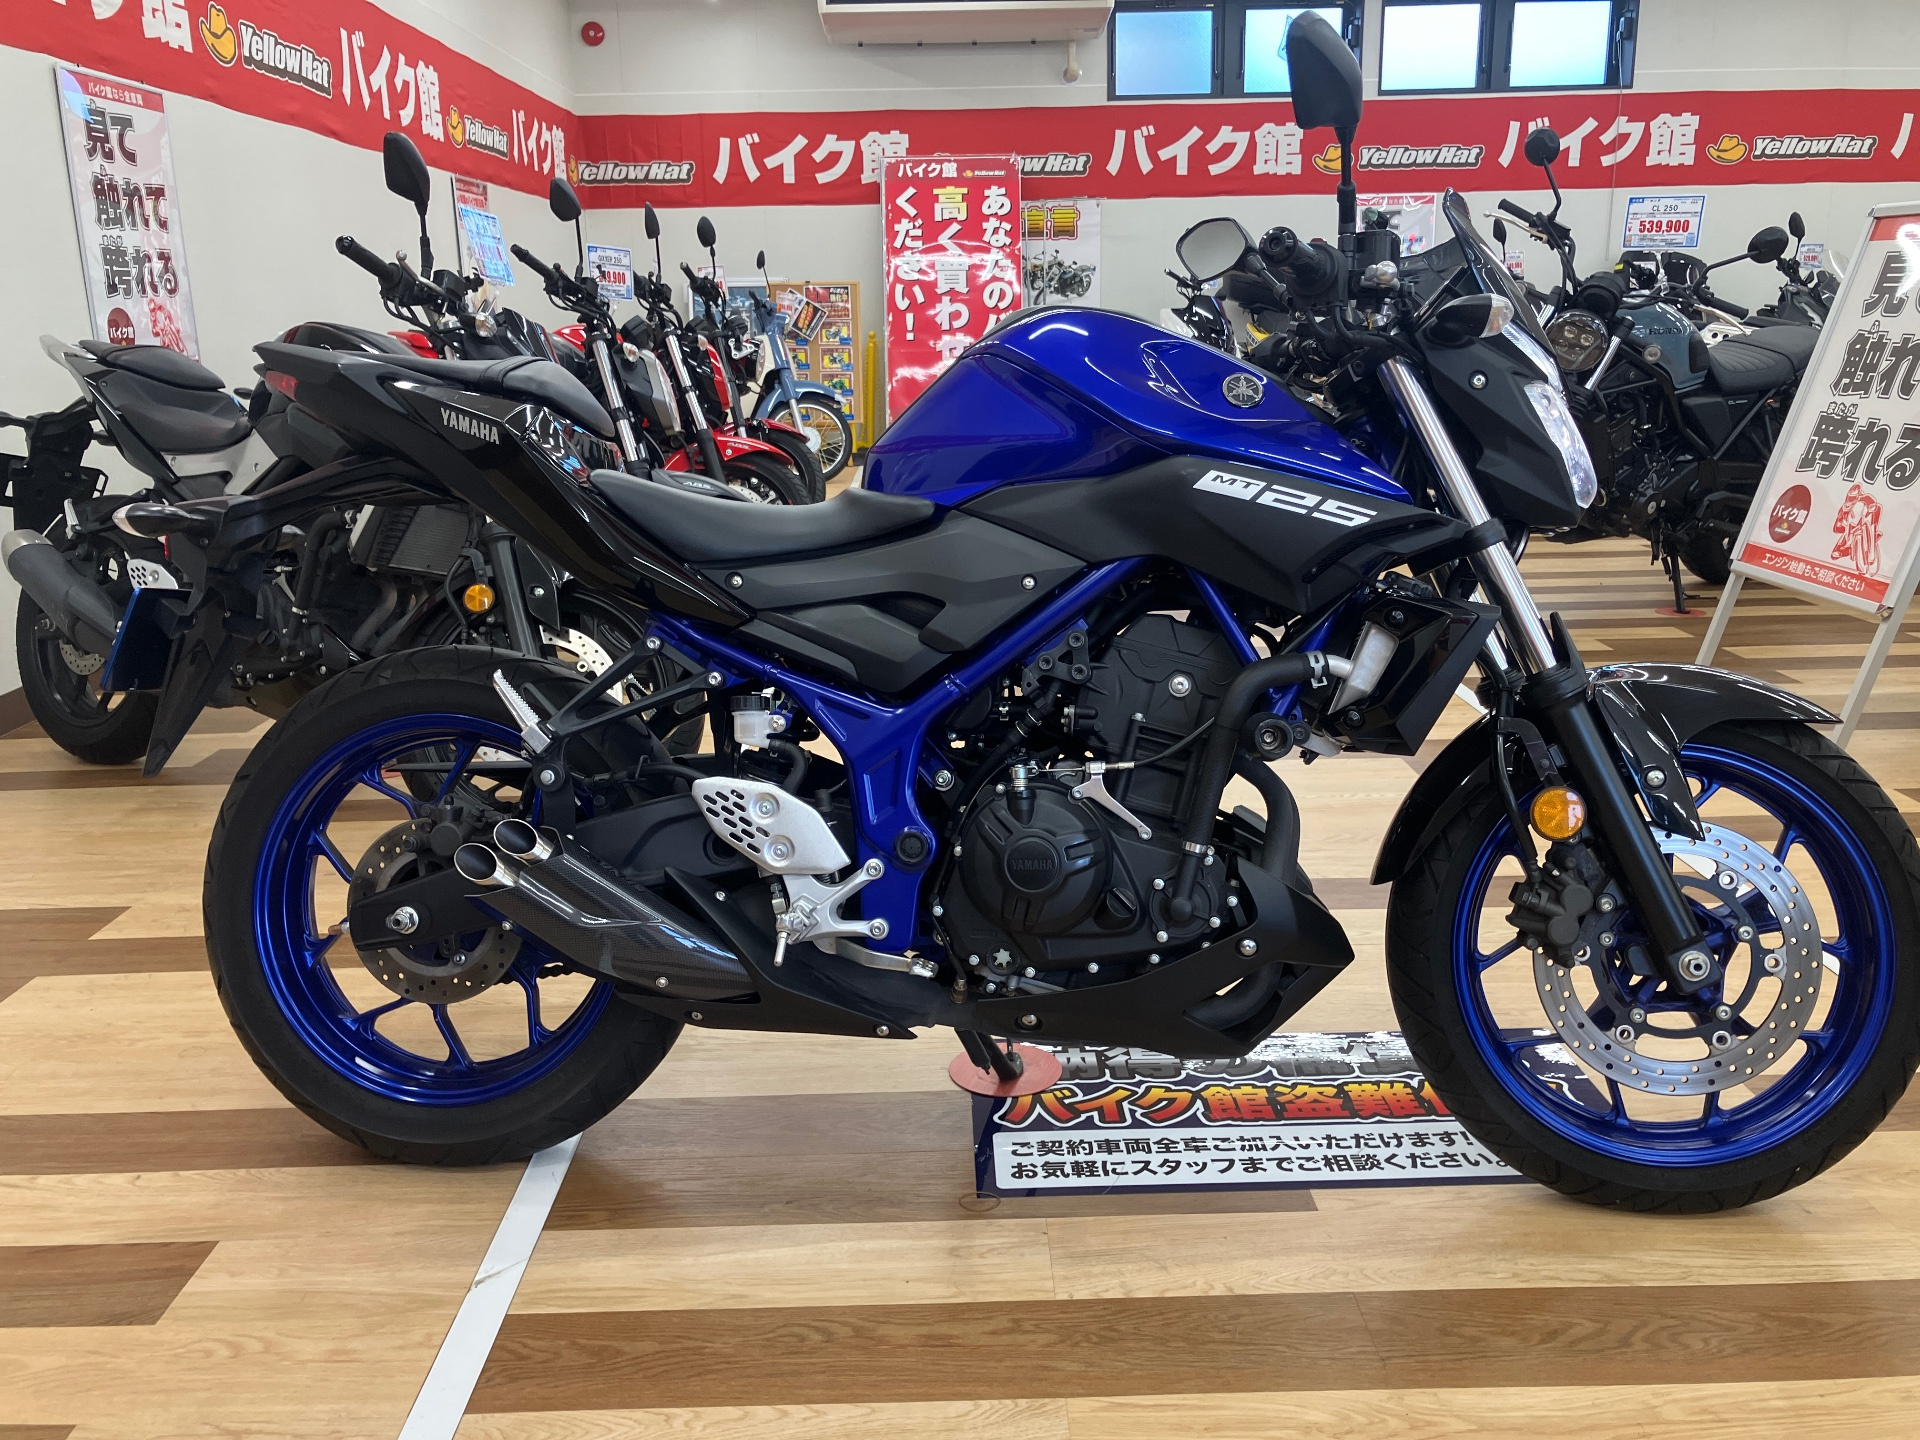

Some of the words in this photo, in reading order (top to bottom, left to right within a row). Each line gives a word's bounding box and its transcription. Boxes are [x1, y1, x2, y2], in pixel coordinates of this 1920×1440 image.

[239, 20, 332, 92] YellowHat
[340, 27, 444, 142] バイク館
[464, 115, 508, 156] YellowHat
[512, 109, 567, 182] バイク館
[81, 103, 137, 167] 見て
[577, 162, 692, 183] YellowHat
[1106, 122, 1304, 176] バイク館
[1359, 146, 1480, 167] YellowHat
[1754, 136, 1874, 157] YellowHat
[898, 162, 957, 178] バイク館
[90, 171, 169, 234] 触れて
[1652, 204, 1661, 212] CL
[1664, 204, 1679, 212] 250
[1638, 219, 1690, 235] 539,900
[99, 244, 179, 299] 跨れる
[1861, 250, 1920, 317] 見
[1648, 327, 1685, 336] HONDA
[440, 407, 500, 445] YAMAHA
[1827, 401, 1858, 416] またが
[1795, 411, 1920, 491] 跨れる
[1209, 474, 1260, 490] MT
[1256, 484, 1378, 527] 25
[1773, 503, 1808, 525] バイク館
[1761, 553, 1866, 592] エンジン始動もご相談ください
[1011, 858, 1054, 871] YAMAHA
